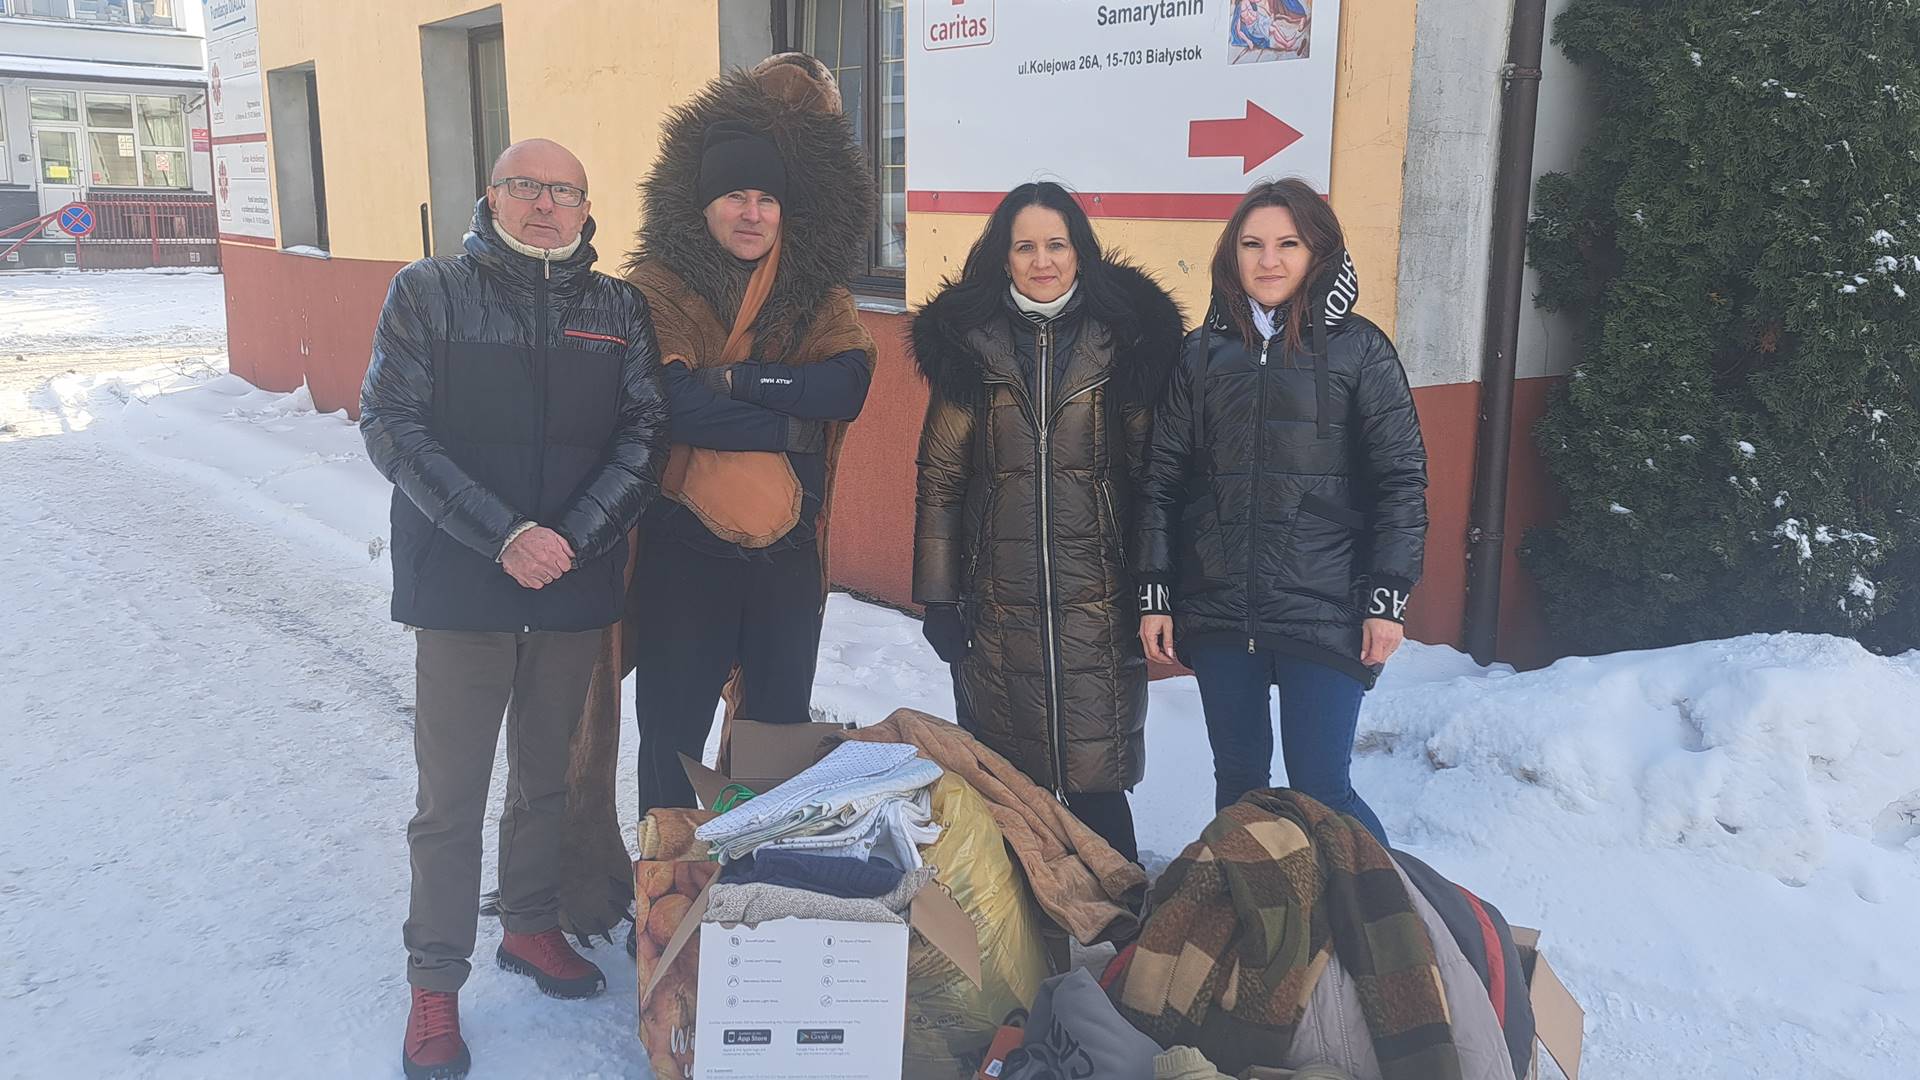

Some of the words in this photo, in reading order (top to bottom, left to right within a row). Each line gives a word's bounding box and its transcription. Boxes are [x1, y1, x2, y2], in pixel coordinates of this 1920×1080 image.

[1097, 0, 1204, 26] Samarytanin
[930, 13, 987, 42] caritas
[1018, 58, 1076, 75] ul.Kolejowa
[1079, 54, 1102, 70] 26A,
[1106, 50, 1142, 67] 15-703
[1146, 45, 1202, 66] Białystok
[737, 1034, 751, 1043] App
[752, 1034, 768, 1042] Store
